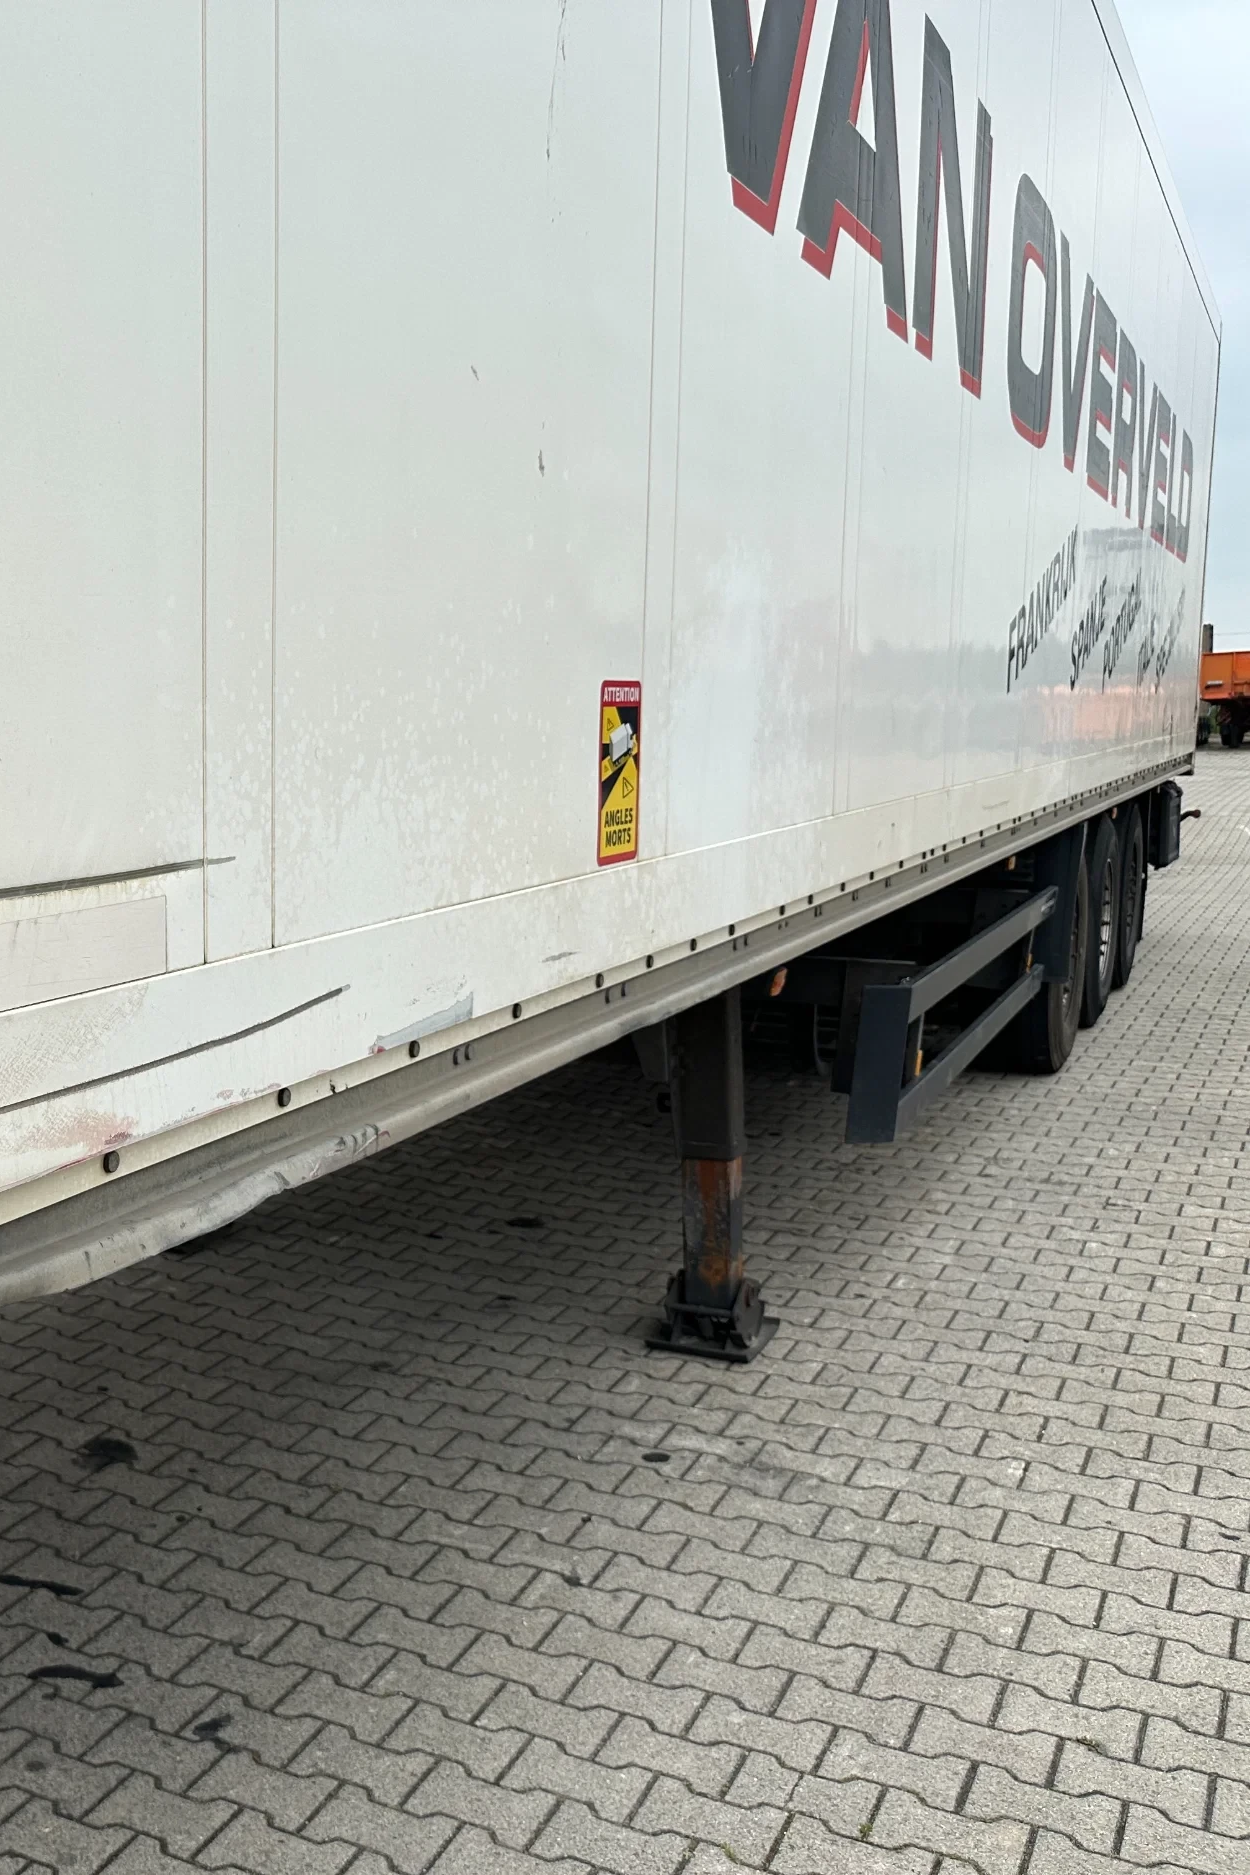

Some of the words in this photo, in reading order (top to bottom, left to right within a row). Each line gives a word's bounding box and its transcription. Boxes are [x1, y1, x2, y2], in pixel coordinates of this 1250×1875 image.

[711, 0, 993, 399] VAN
[1007, 173, 1193, 562] OVERVELD
[1007, 524, 1078, 695] FRANKRIJK
[1070, 575, 1108, 691] SPANJE
[603, 687, 639, 702] ATTENTION
[604, 808, 633, 829] ANGLES
[605, 828, 631, 848] MORTS
